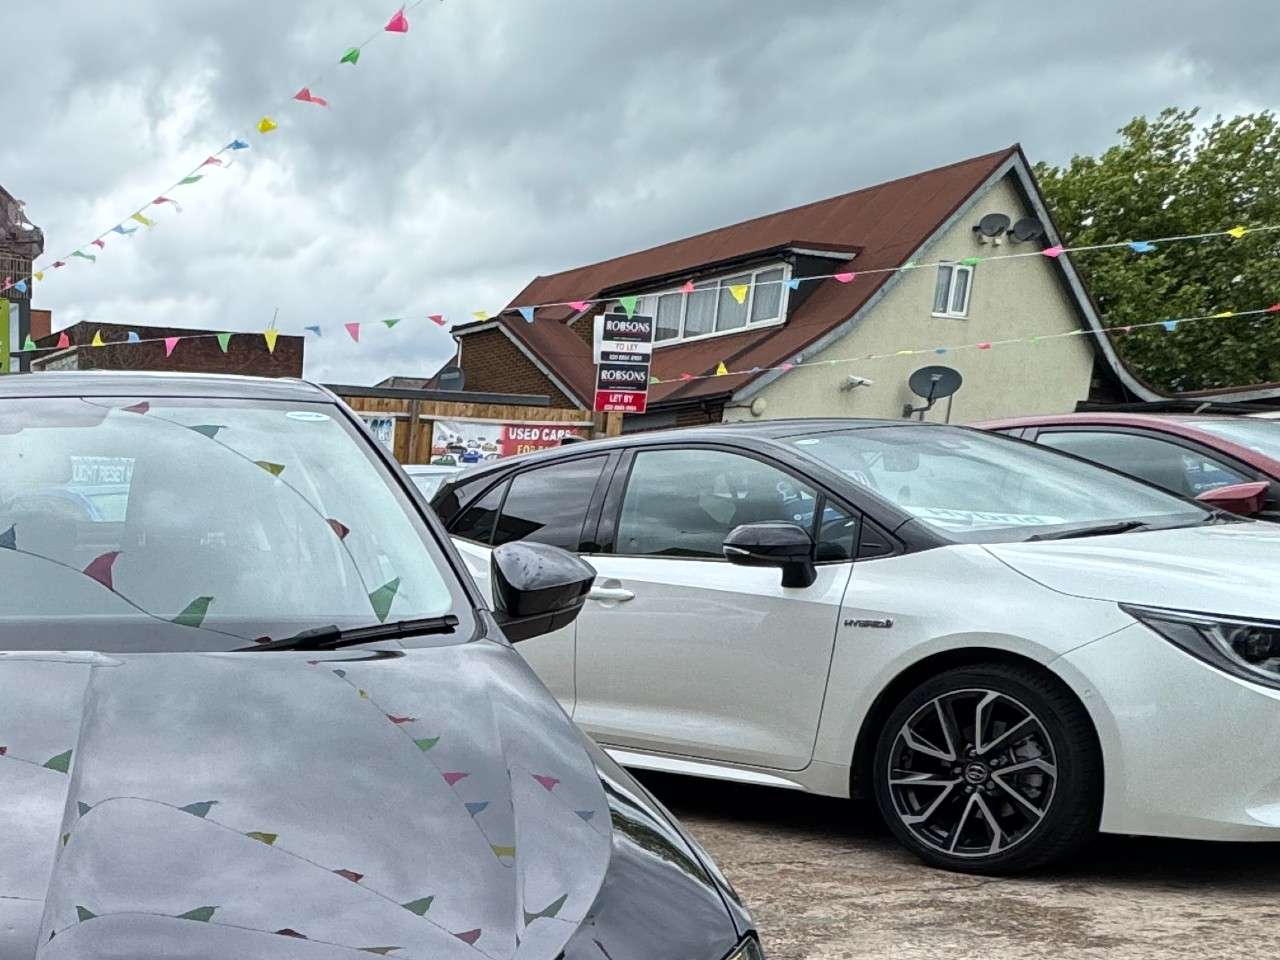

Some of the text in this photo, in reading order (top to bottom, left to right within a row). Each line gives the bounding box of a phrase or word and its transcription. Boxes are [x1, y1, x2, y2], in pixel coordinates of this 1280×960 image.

[606, 321, 650, 332] ROBSONS
[601, 370, 646, 381] ROBSONS
[609, 394, 634, 403] LET BY
[508, 427, 540, 440] USED
